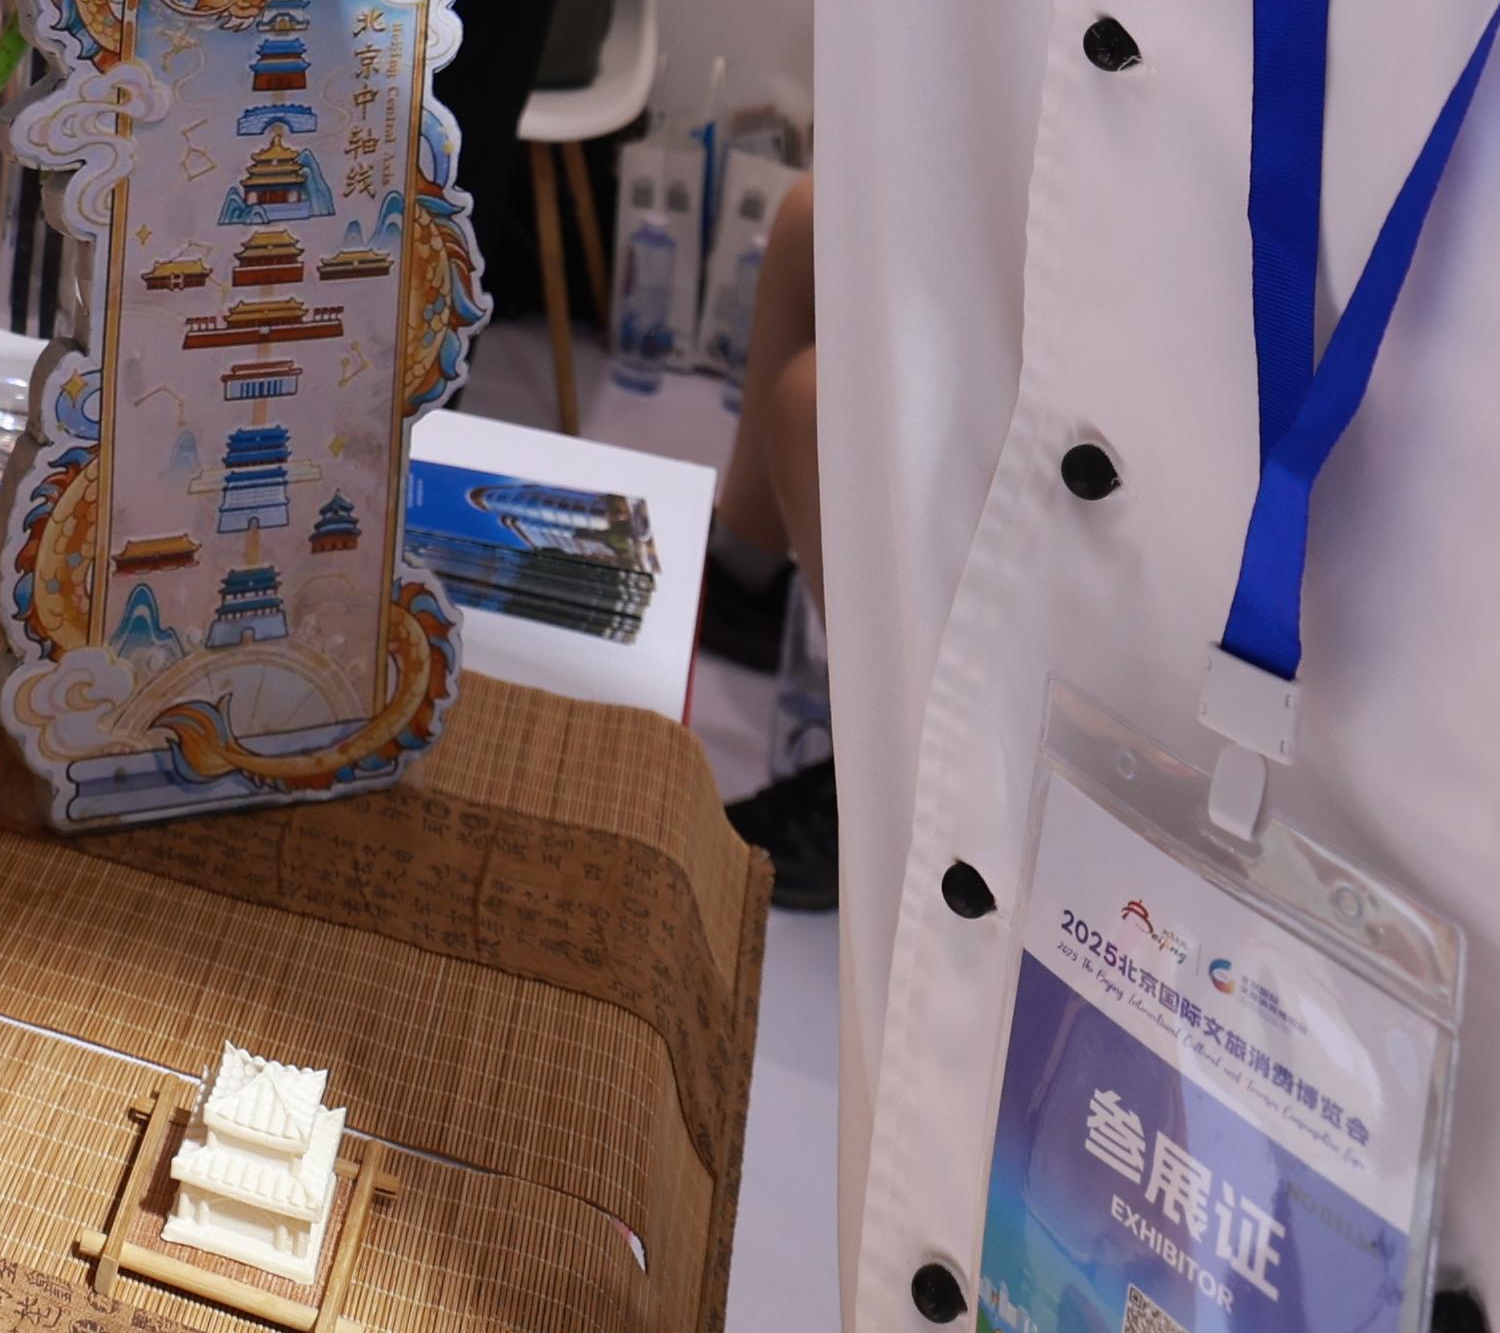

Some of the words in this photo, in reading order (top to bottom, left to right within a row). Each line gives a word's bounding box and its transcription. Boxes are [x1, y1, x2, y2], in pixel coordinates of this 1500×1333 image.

[343, 7, 386, 200] 北京中轴线
[1110, 1194, 1234, 1316] EXHIBITOR
